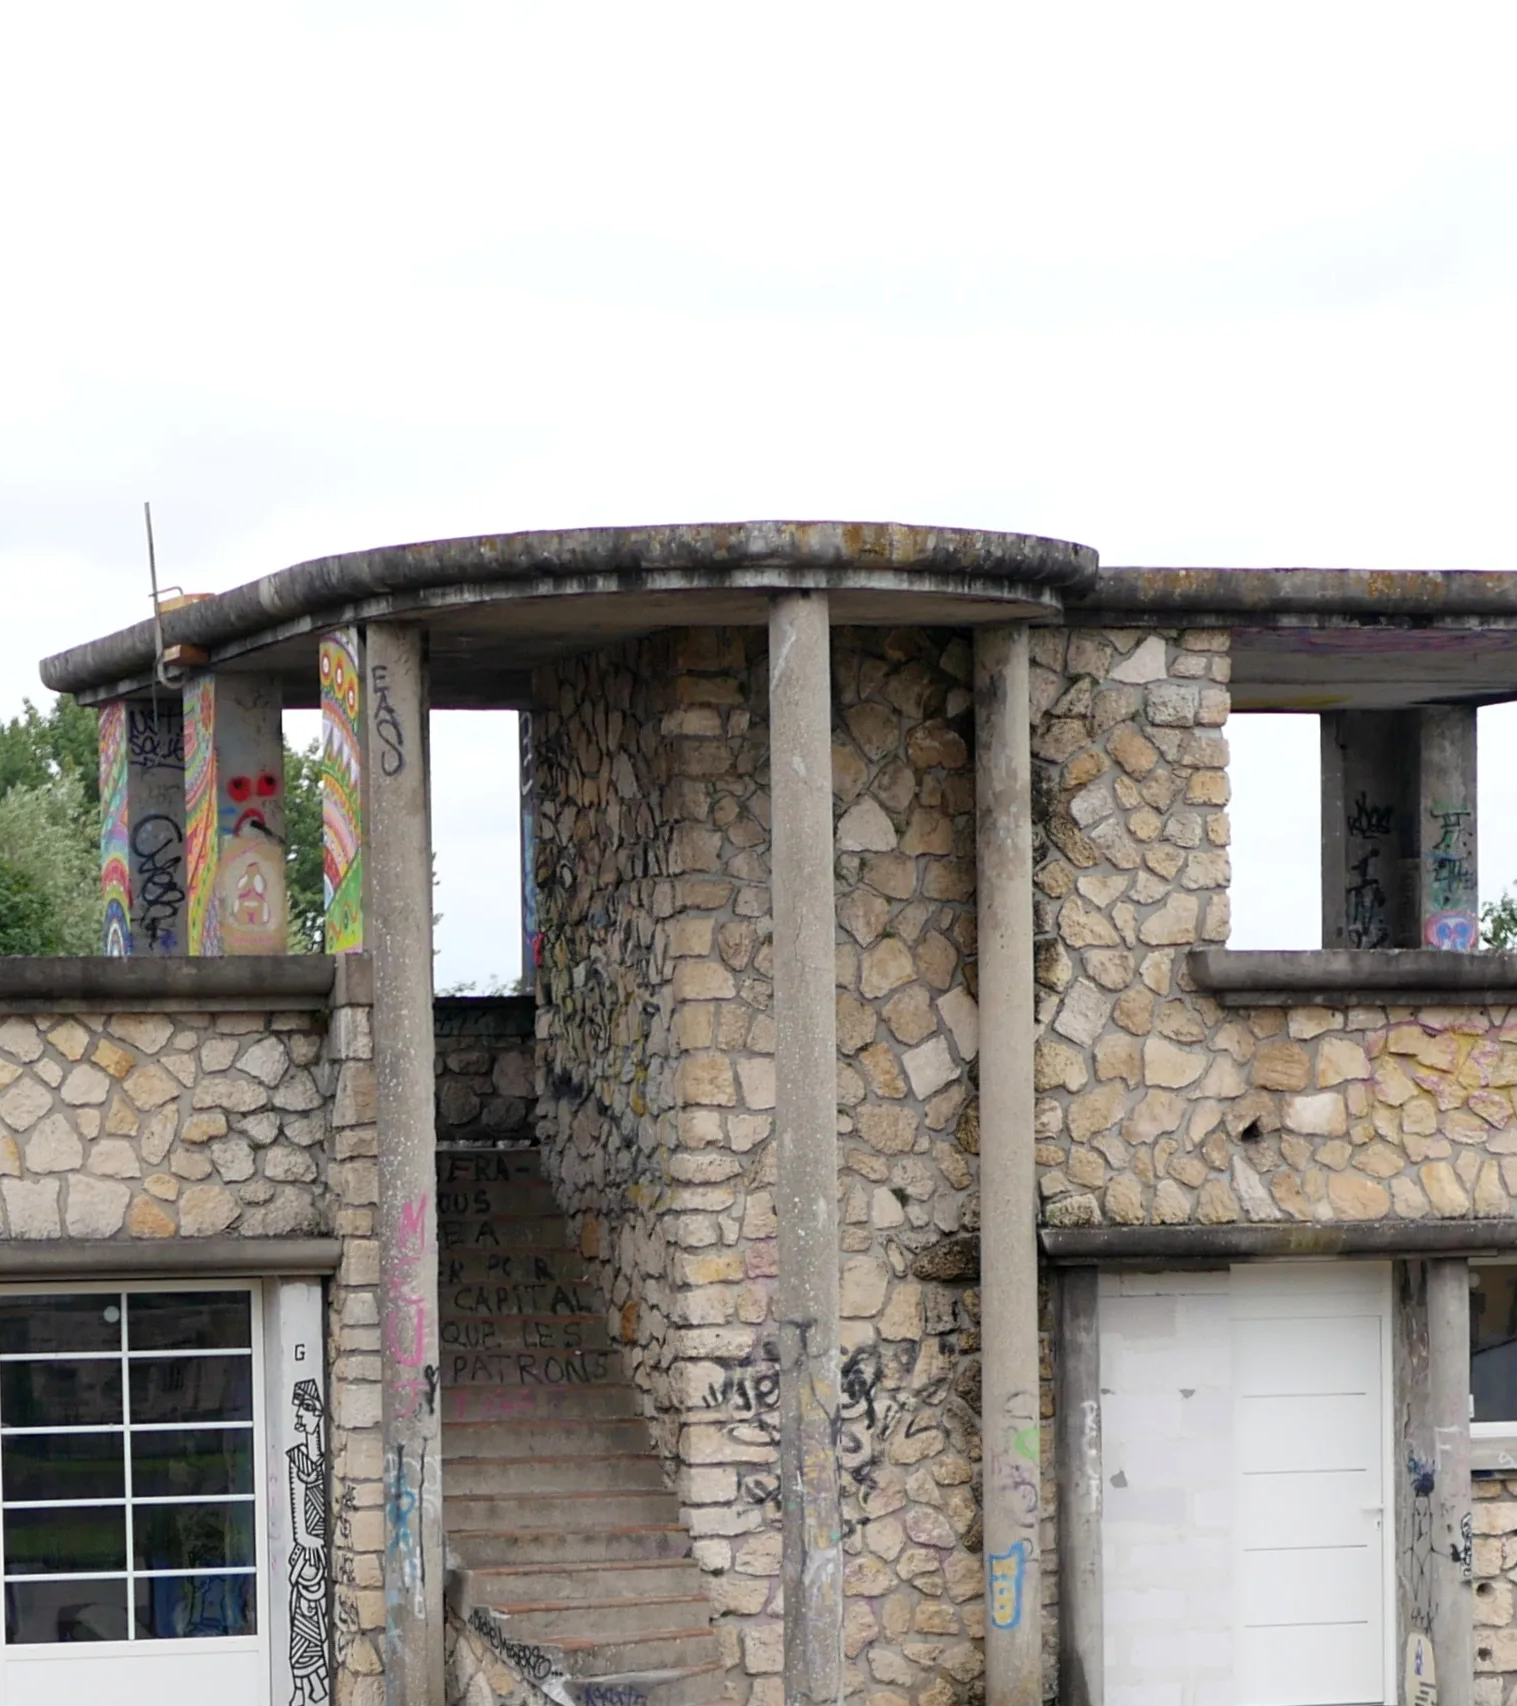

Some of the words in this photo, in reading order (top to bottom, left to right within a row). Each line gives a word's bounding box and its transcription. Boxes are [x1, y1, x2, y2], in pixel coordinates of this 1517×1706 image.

[441, 1320, 502, 1349] QUE
[522, 1321, 582, 1348] LES
[453, 1351, 615, 1385] PATRONS
